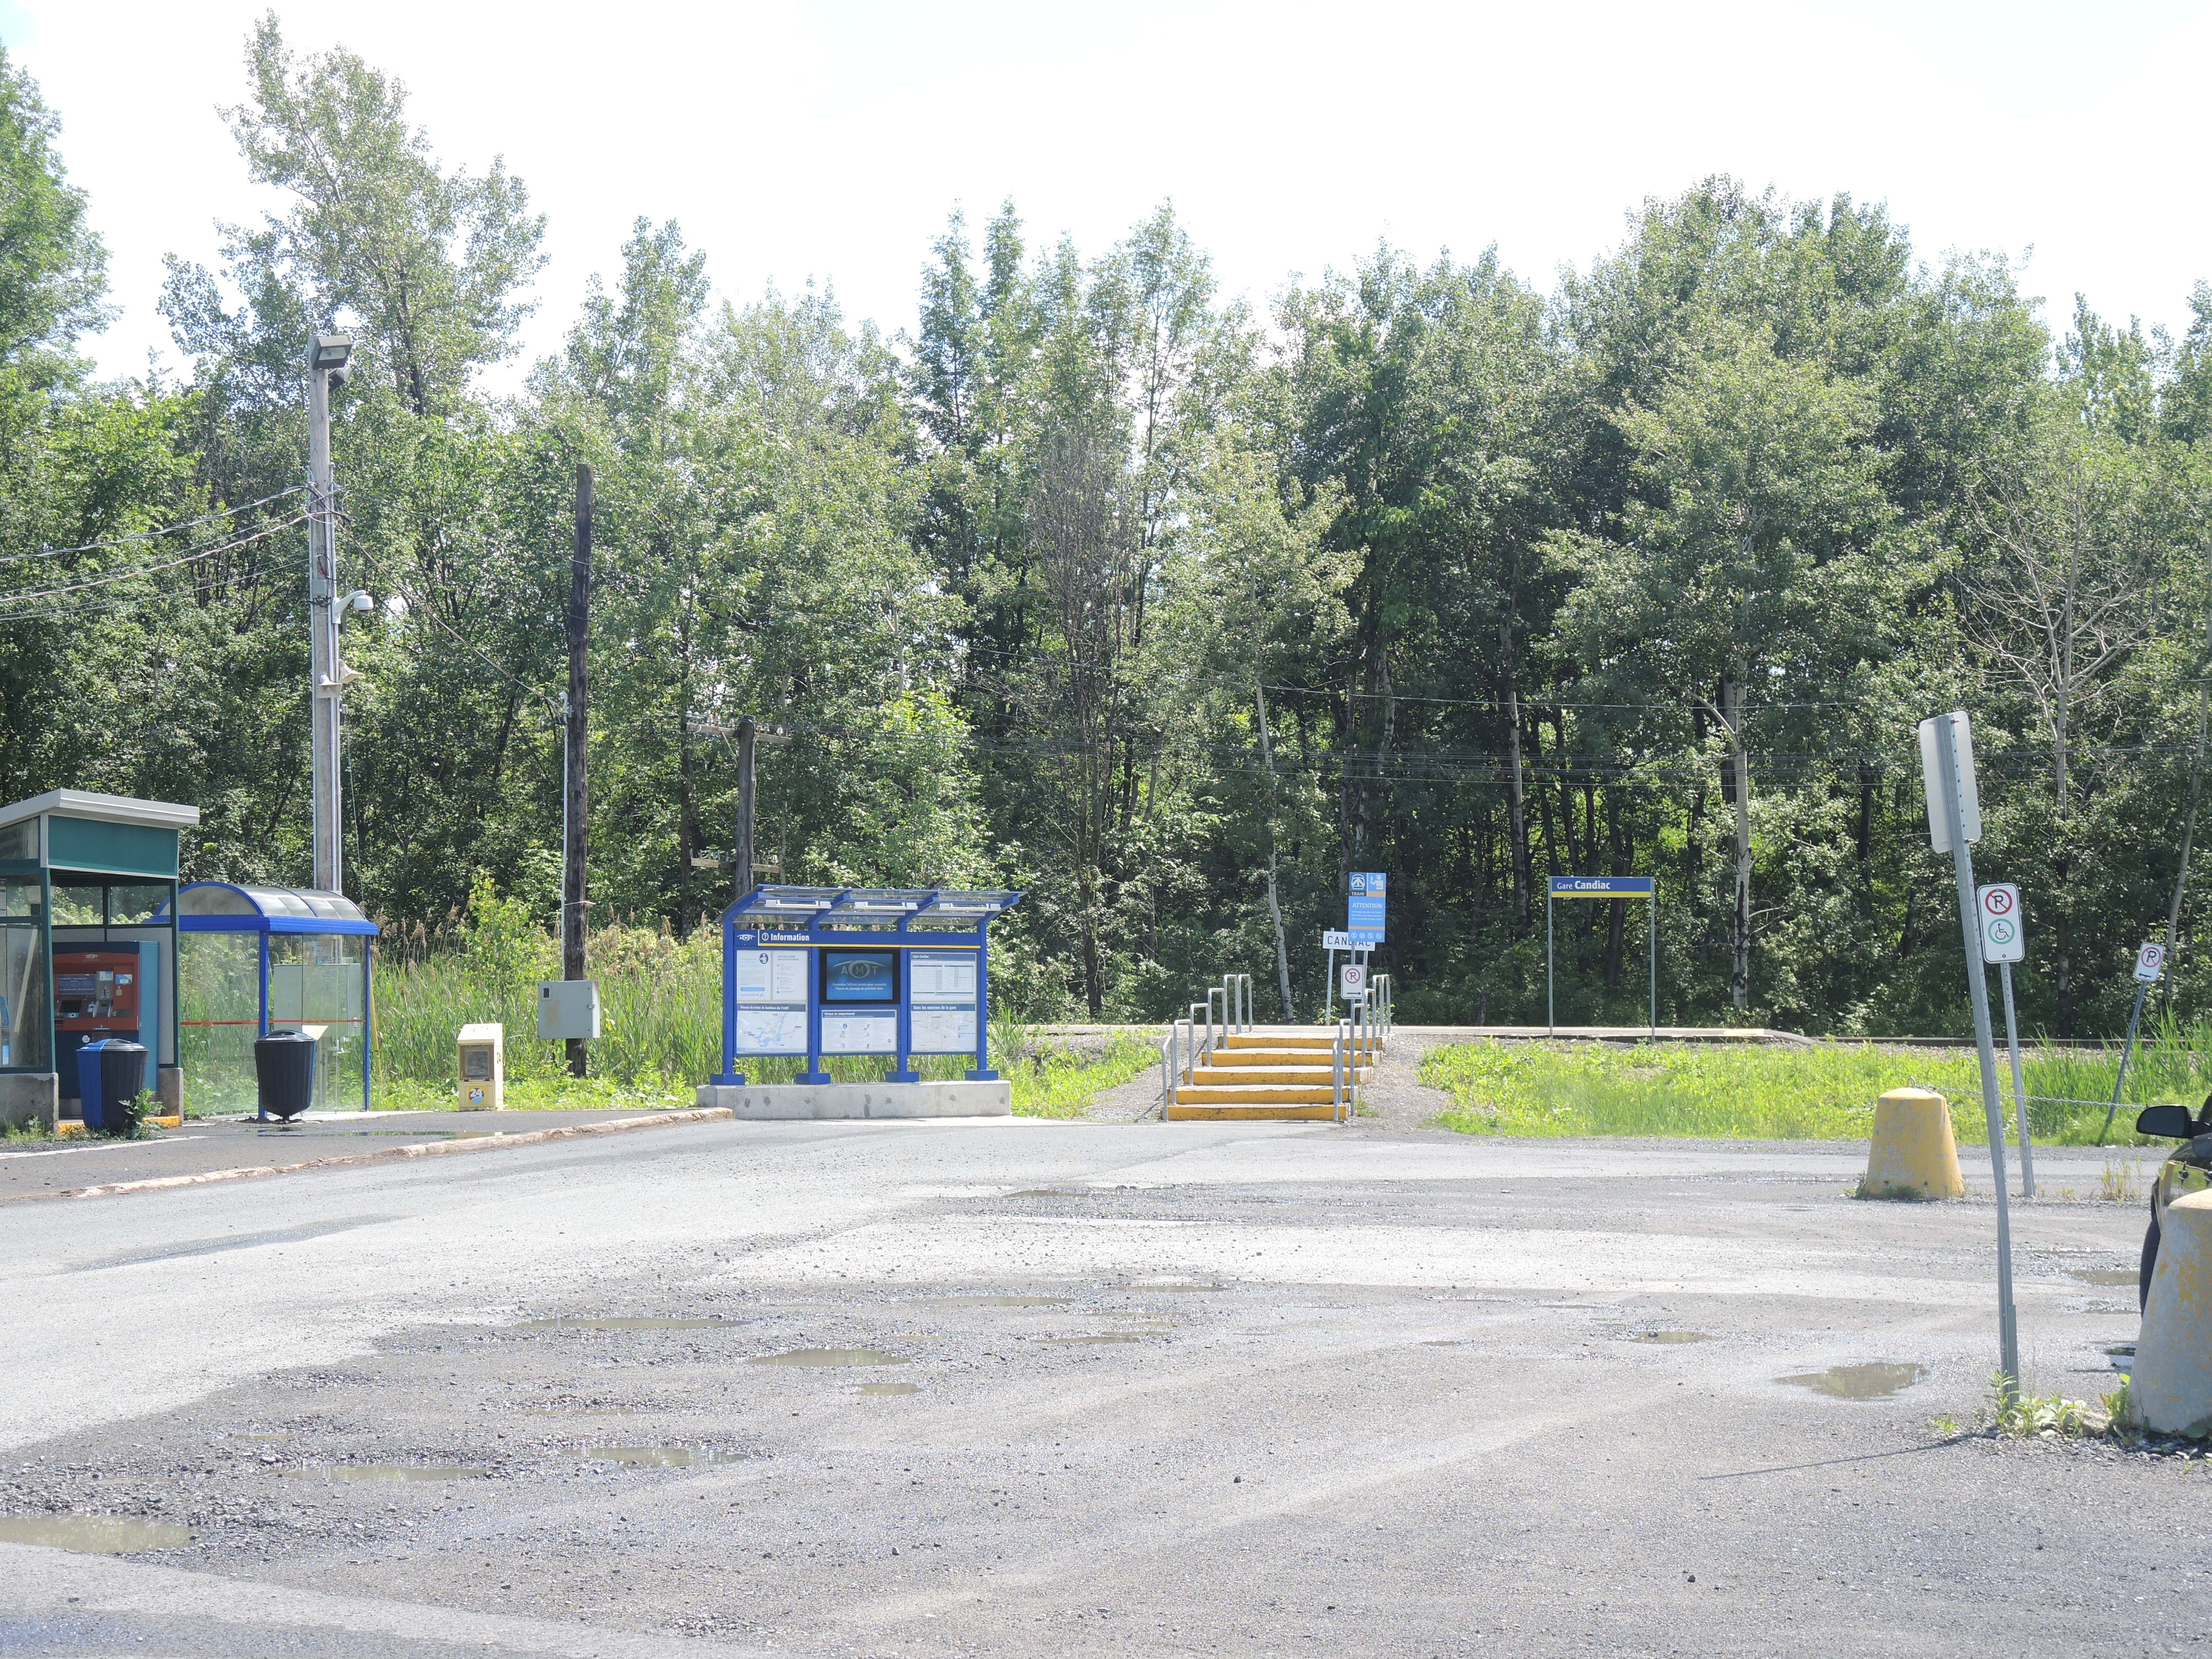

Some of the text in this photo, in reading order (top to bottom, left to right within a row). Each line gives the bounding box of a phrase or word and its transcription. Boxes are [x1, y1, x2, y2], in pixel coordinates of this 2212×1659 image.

[1574, 880, 1610, 889] Candiac
[770, 933, 810, 941] Information
[1327, 935, 1371, 947] CANIAC
[470, 1088, 483, 1097] 24
